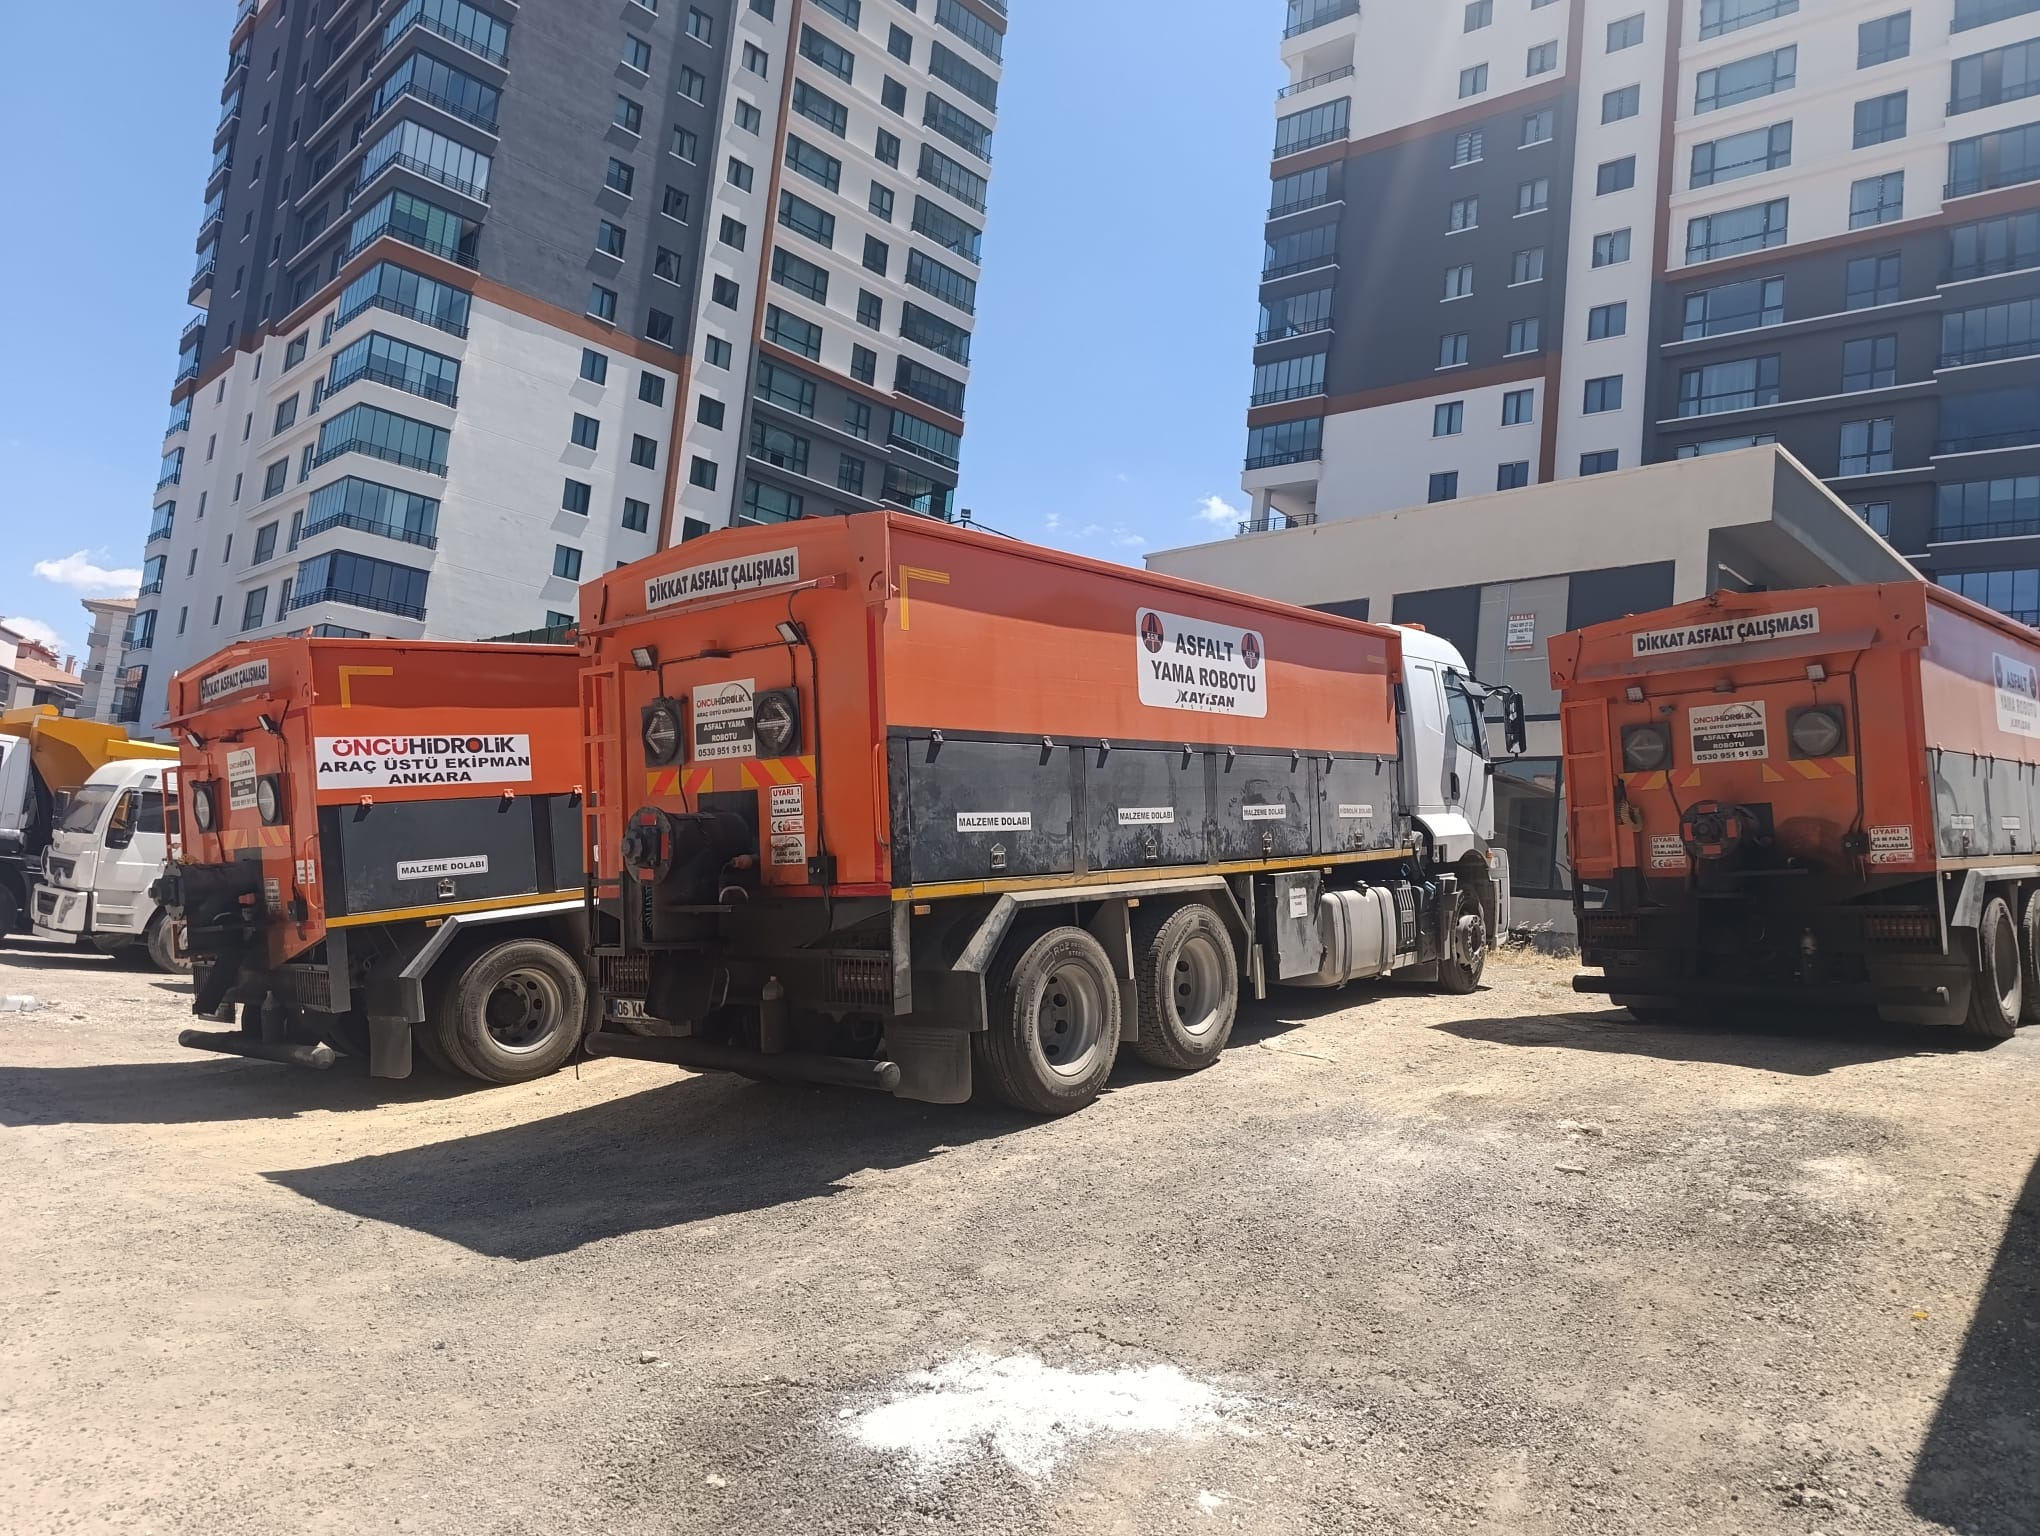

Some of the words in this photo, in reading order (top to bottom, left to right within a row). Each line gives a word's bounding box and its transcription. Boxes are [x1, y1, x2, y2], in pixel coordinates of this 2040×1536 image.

[649, 578, 688, 603] DİKKAT
[690, 566, 729, 593] ASFALT
[731, 555, 794, 590] ÇALIŞMASI
[1637, 633, 1685, 651] DİKKAT
[1687, 625, 1734, 645] ASFALT
[1737, 613, 1814, 642] ÇALIŞMASI
[1175, 633, 1234, 662] ASFALT
[1151, 660, 1195, 685] YAMA
[1199, 667, 1256, 693] ROBOTU
[2006, 671, 2028, 692] ASFALT
[703, 722, 726, 731] ASFALT
[728, 719, 745, 728] YAMA
[711, 732, 738, 742] ROBOTU
[1703, 733, 1730, 741] ASFALT
[1732, 731, 1754, 739] YAMA
[332, 737, 515, 757] ÖNCÜHİDROLİK
[698, 748, 715, 757] 0530
[717, 746, 730, 755] 951
[732, 745, 741, 754] 91
[743, 744, 752, 752] 93
[1713, 741, 1745, 749] ROBOTU
[1697, 753, 1718, 761] 0530
[319, 760, 377, 774] ARAÇ
[384, 757, 438, 770] ÜSTÜ
[445, 755, 530, 769] EKİPMAN
[389, 771, 472, 785] ANKARA
[773, 788, 794, 797] UYARI
[1119, 811, 1150, 821] MALZEME
[1151, 811, 1173, 820] DOLABI
[1243, 808, 1268, 816] MALZEME
[958, 817, 999, 826] MALZEME
[1001, 816, 1030, 826] DOLABI
[401, 863, 448, 875] MALZEME
[450, 860, 485, 870] DOLABI
[617, 1001, 629, 1016] 06
